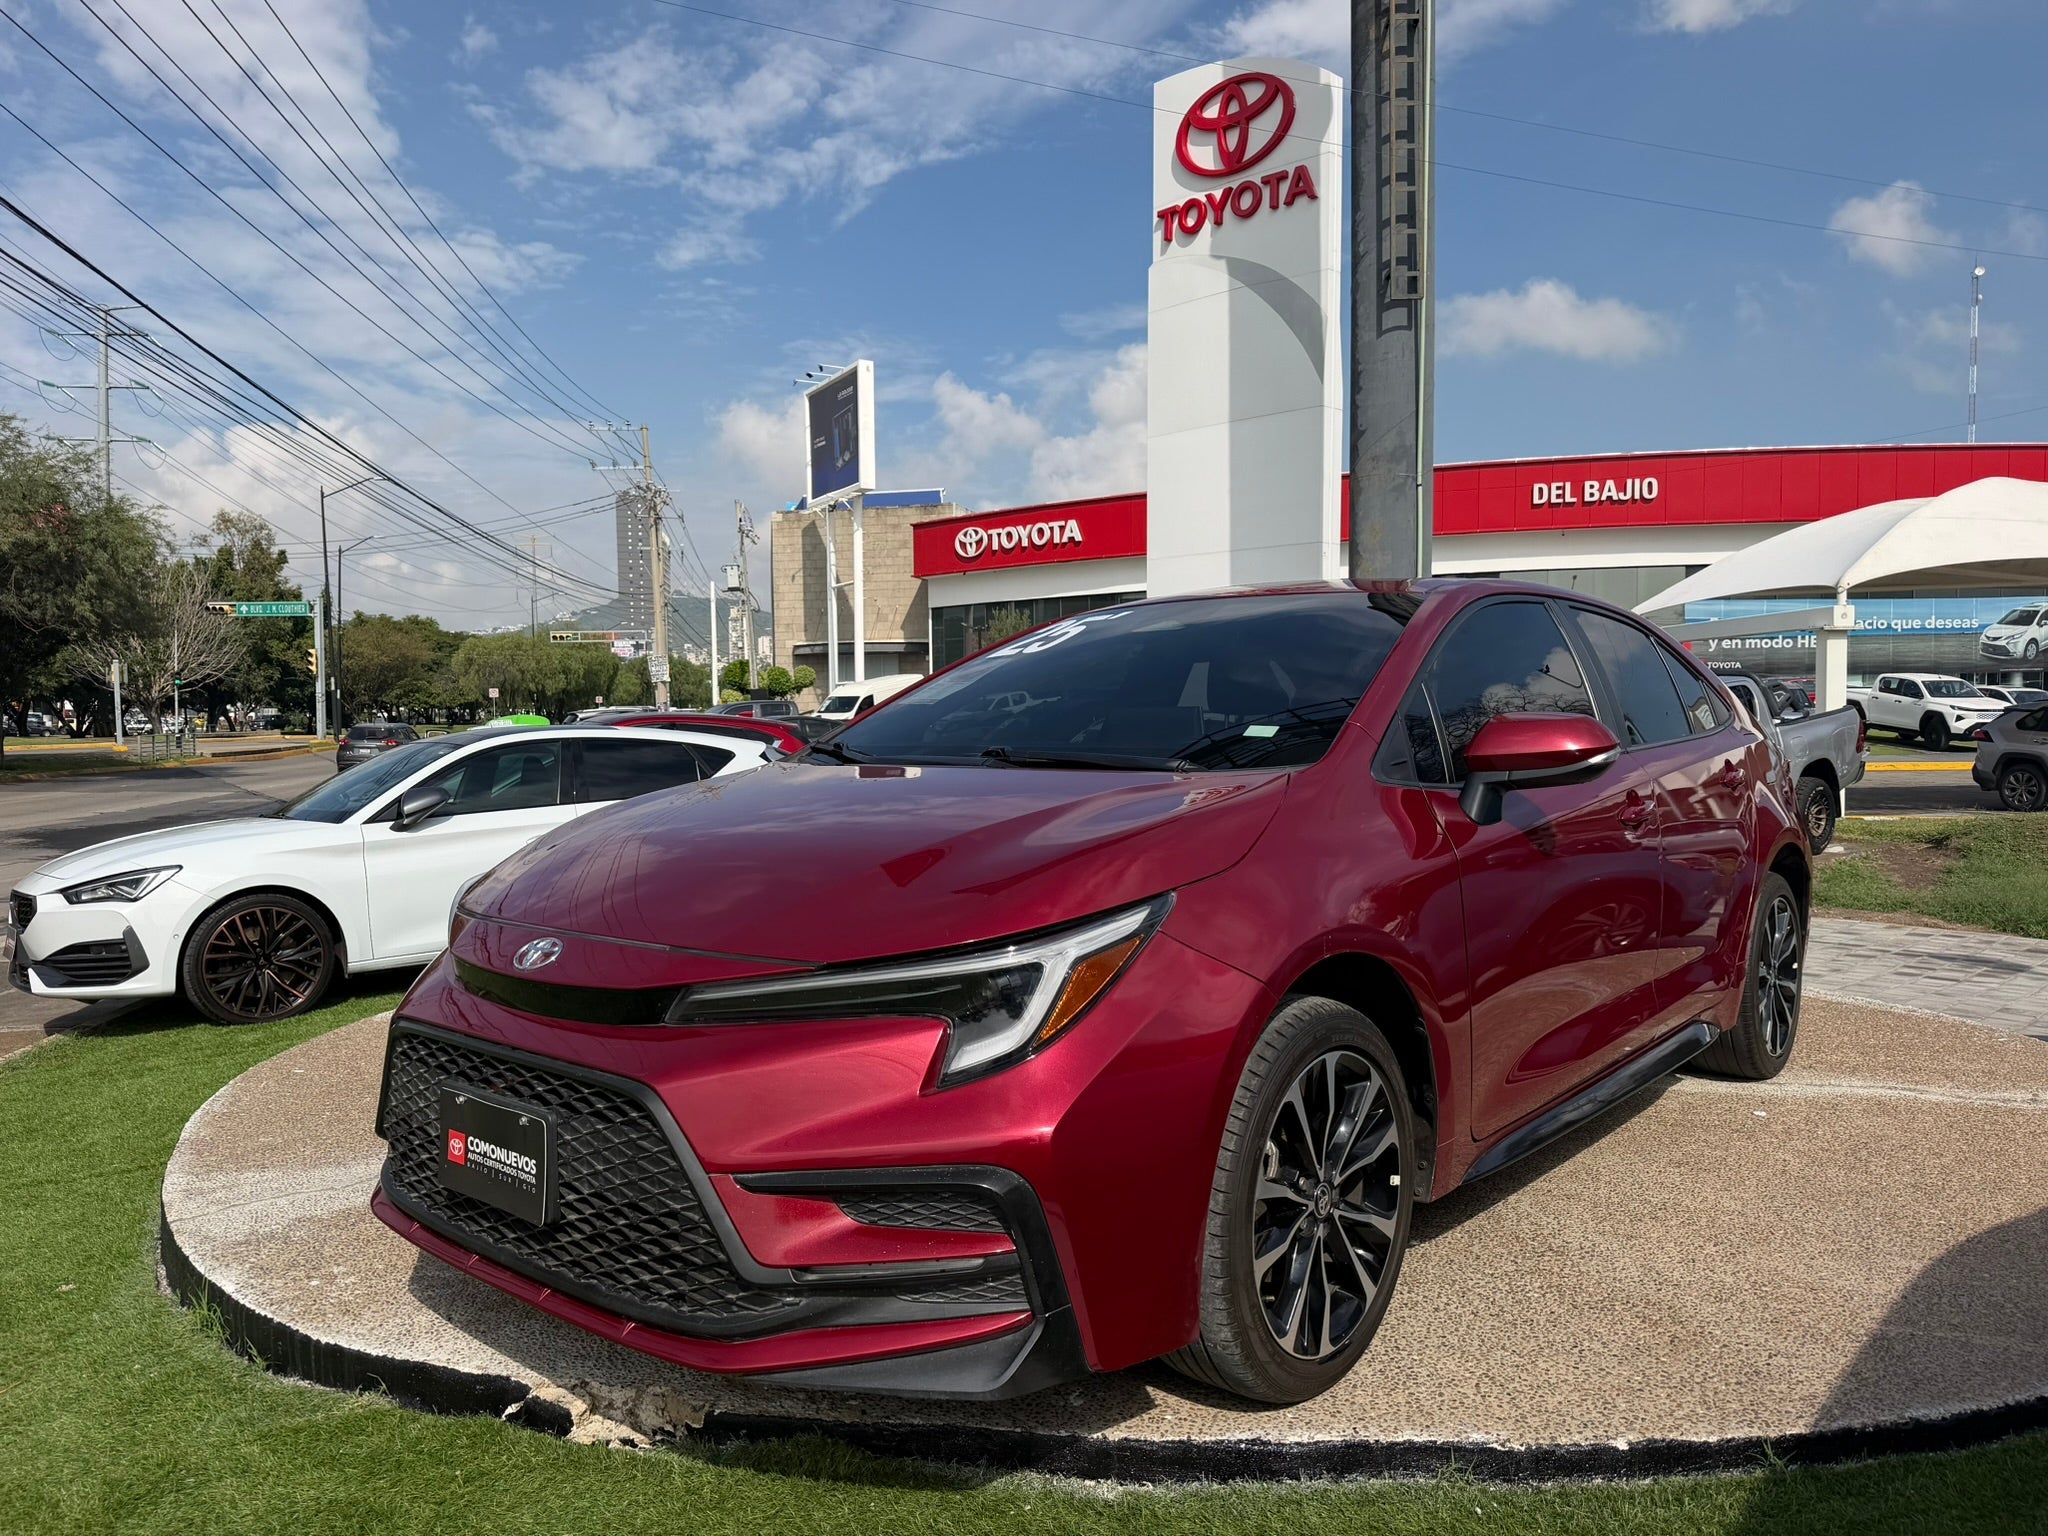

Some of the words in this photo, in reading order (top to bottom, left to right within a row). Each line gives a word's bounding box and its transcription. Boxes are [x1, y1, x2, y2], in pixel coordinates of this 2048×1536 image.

[1157, 164, 1318, 242] TOYOTA
[1533, 481, 1577, 505] DEL
[1583, 477, 1659, 502] BAJIO
[988, 519, 1082, 551] TOYOTA
[1855, 616, 1888, 630] acio
[1891, 618, 1921, 632] que
[1925, 615, 1979, 629] deseas
[1708, 639, 1719, 652] y
[1722, 637, 1742, 649] en
[1745, 635, 1794, 649] modo
[1797, 635, 1817, 648] HE
[1707, 661, 1742, 669] TOYOTA
[467, 1136, 537, 1175] COMONUEVOS
[467, 1151, 484, 1164] AUTOS
[483, 1157, 518, 1177] CERTIFICADOS
[517, 1170, 536, 1184] TOYOTA
